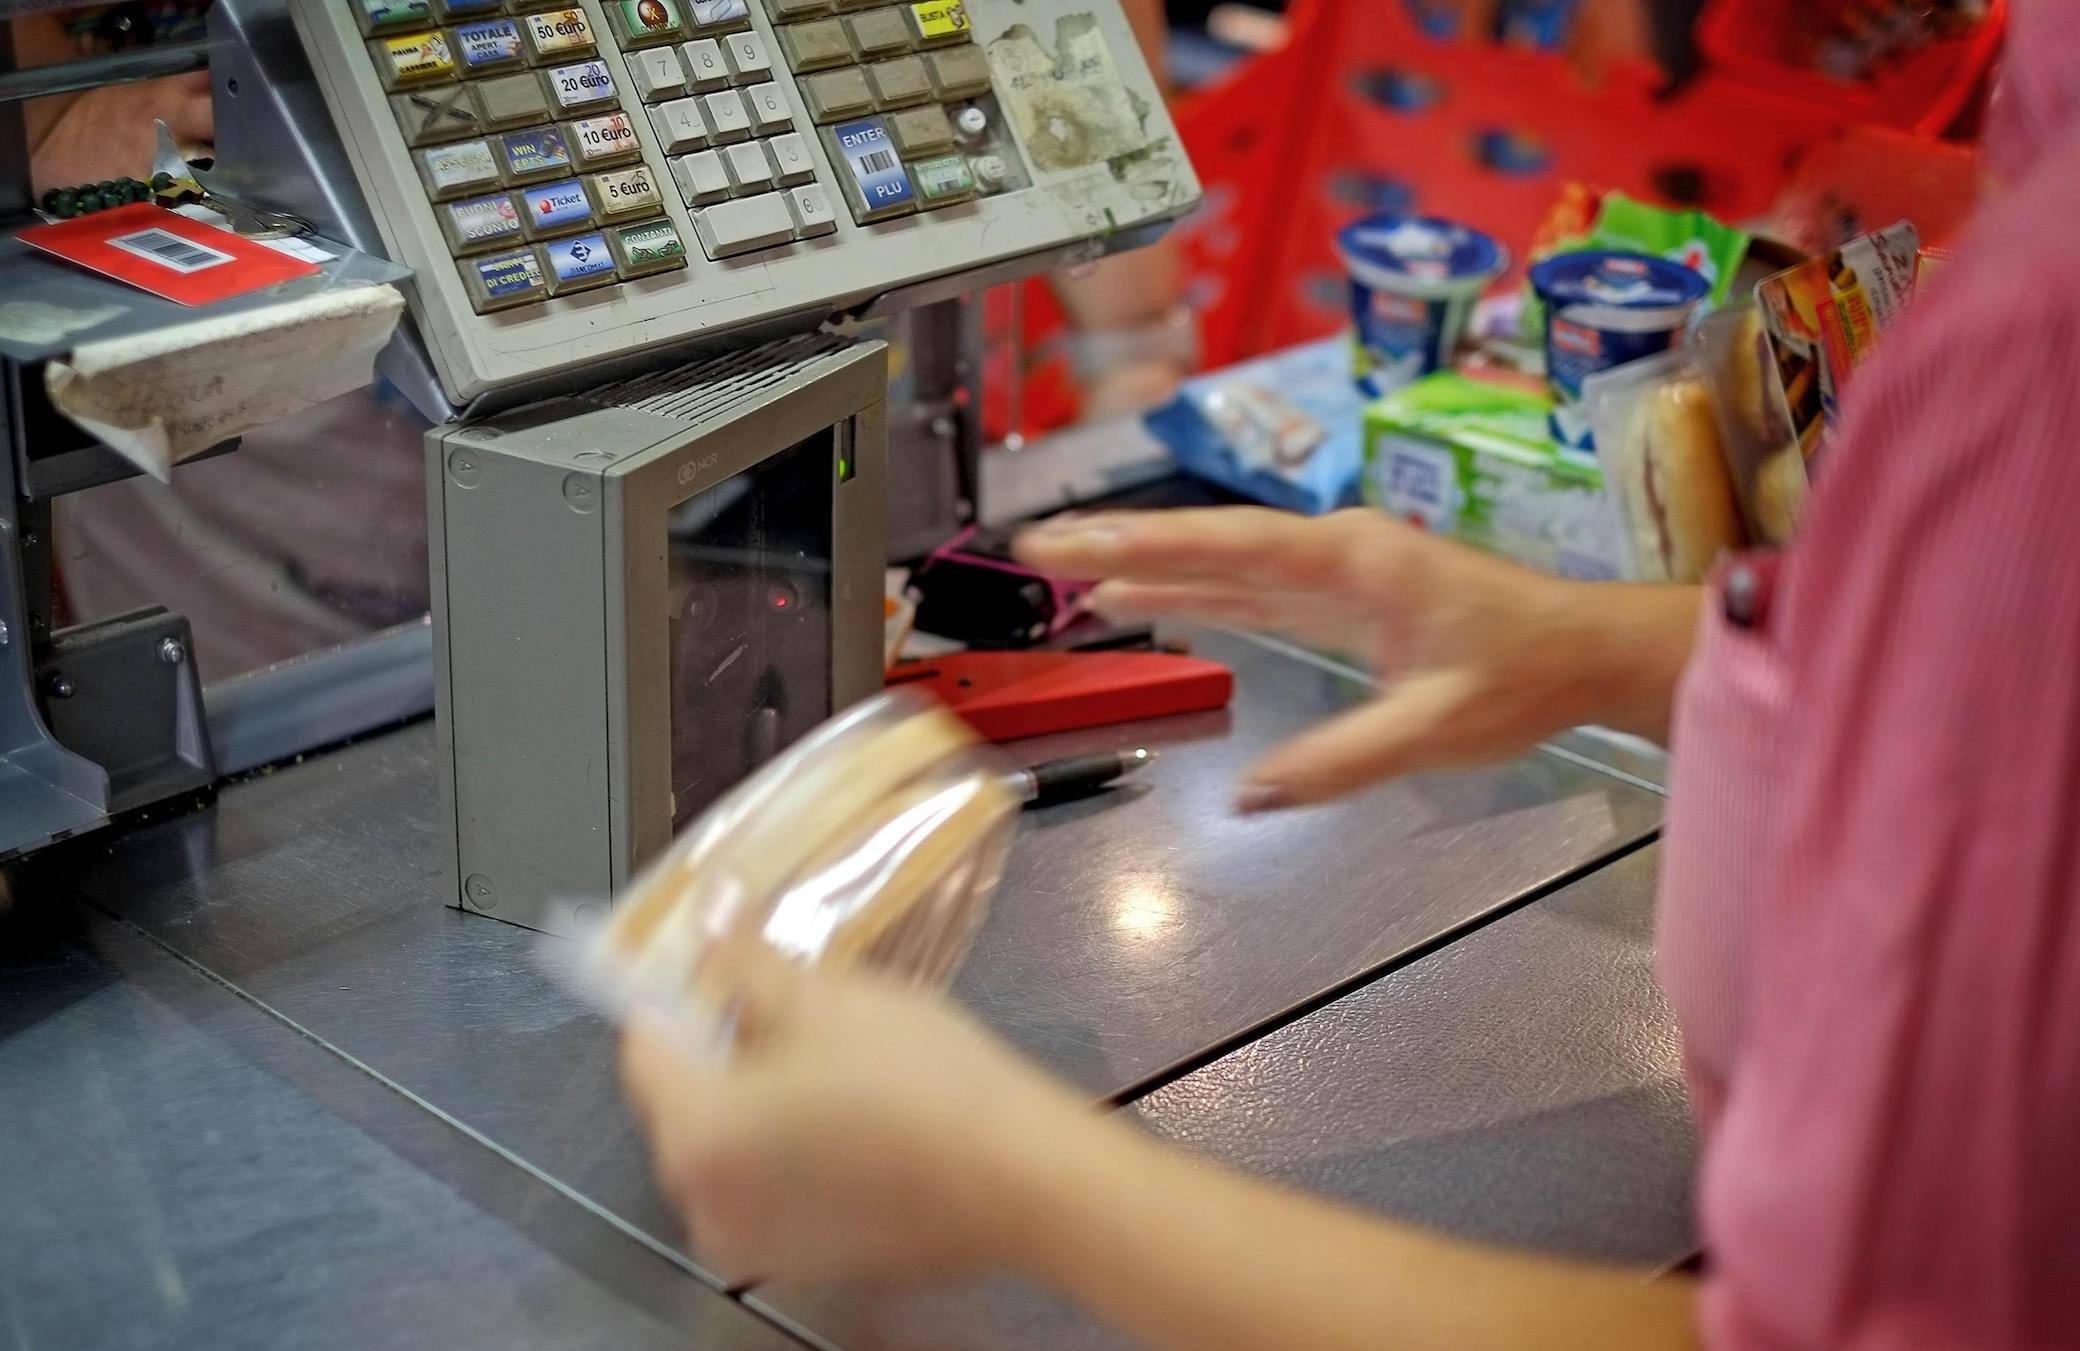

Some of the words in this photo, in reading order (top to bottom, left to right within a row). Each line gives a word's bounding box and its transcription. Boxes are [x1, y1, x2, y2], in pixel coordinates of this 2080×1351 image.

[461, 26, 513, 42] TOTALE
[537, 25, 554, 39] 50
[555, 21, 586, 36] €uro
[701, 52, 714, 68] 8
[743, 44, 755, 60] 9
[656, 60, 667, 76] 7
[561, 78, 578, 92] 20
[580, 74, 610, 89] €uro
[765, 95, 777, 110] 6
[680, 112, 692, 127] 4
[583, 130, 600, 145] 10
[602, 127, 631, 141] €uro
[842, 127, 887, 149] ENTER
[512, 144, 537, 157] WIN
[610, 185, 619, 198] 5
[620, 181, 650, 196] €uro
[876, 180, 903, 198] PLU
[551, 193, 582, 207] Ticket
[457, 200, 498, 218] BUONI
[466, 219, 521, 239] SCONTO
[625, 227, 673, 244] CONTANTI
[698, 452, 718, 472] NCR
